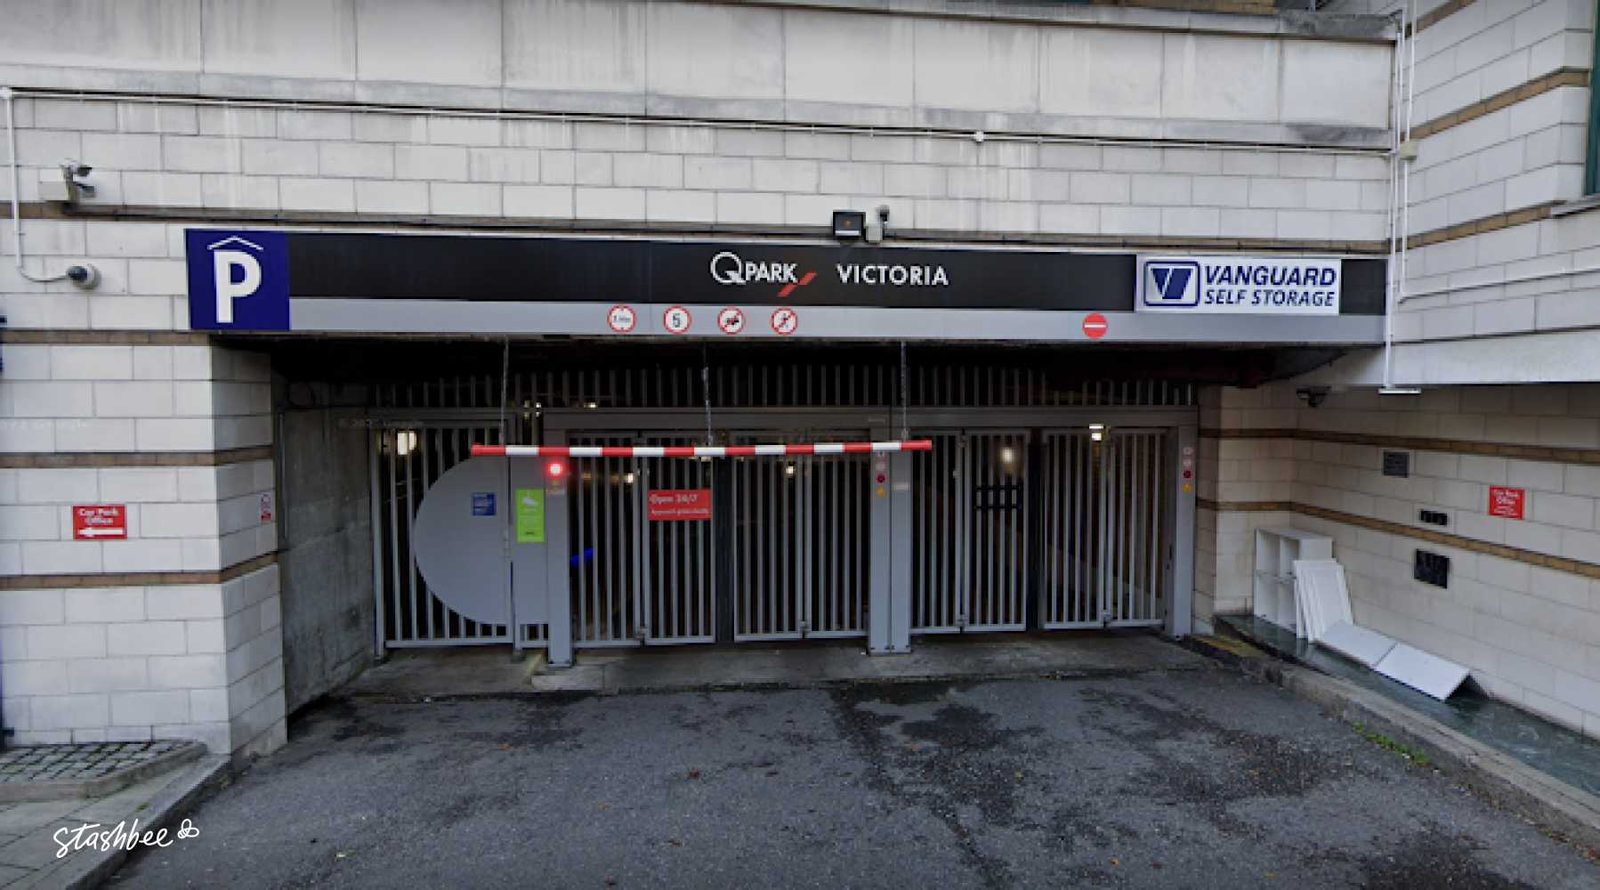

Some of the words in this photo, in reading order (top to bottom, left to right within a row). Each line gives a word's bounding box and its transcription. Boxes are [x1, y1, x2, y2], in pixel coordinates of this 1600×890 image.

[836, 264, 950, 287] VICTORIA
[1204, 265, 1337, 287] VANGUARD
[213, 250, 262, 324] P
[1204, 289, 1248, 305] SELF
[1251, 289, 1336, 307] STORAGE
[672, 312, 682, 328] 5
[78, 508, 95, 517] Car
[97, 507, 120, 518] Park
[85, 516, 114, 526] Office
